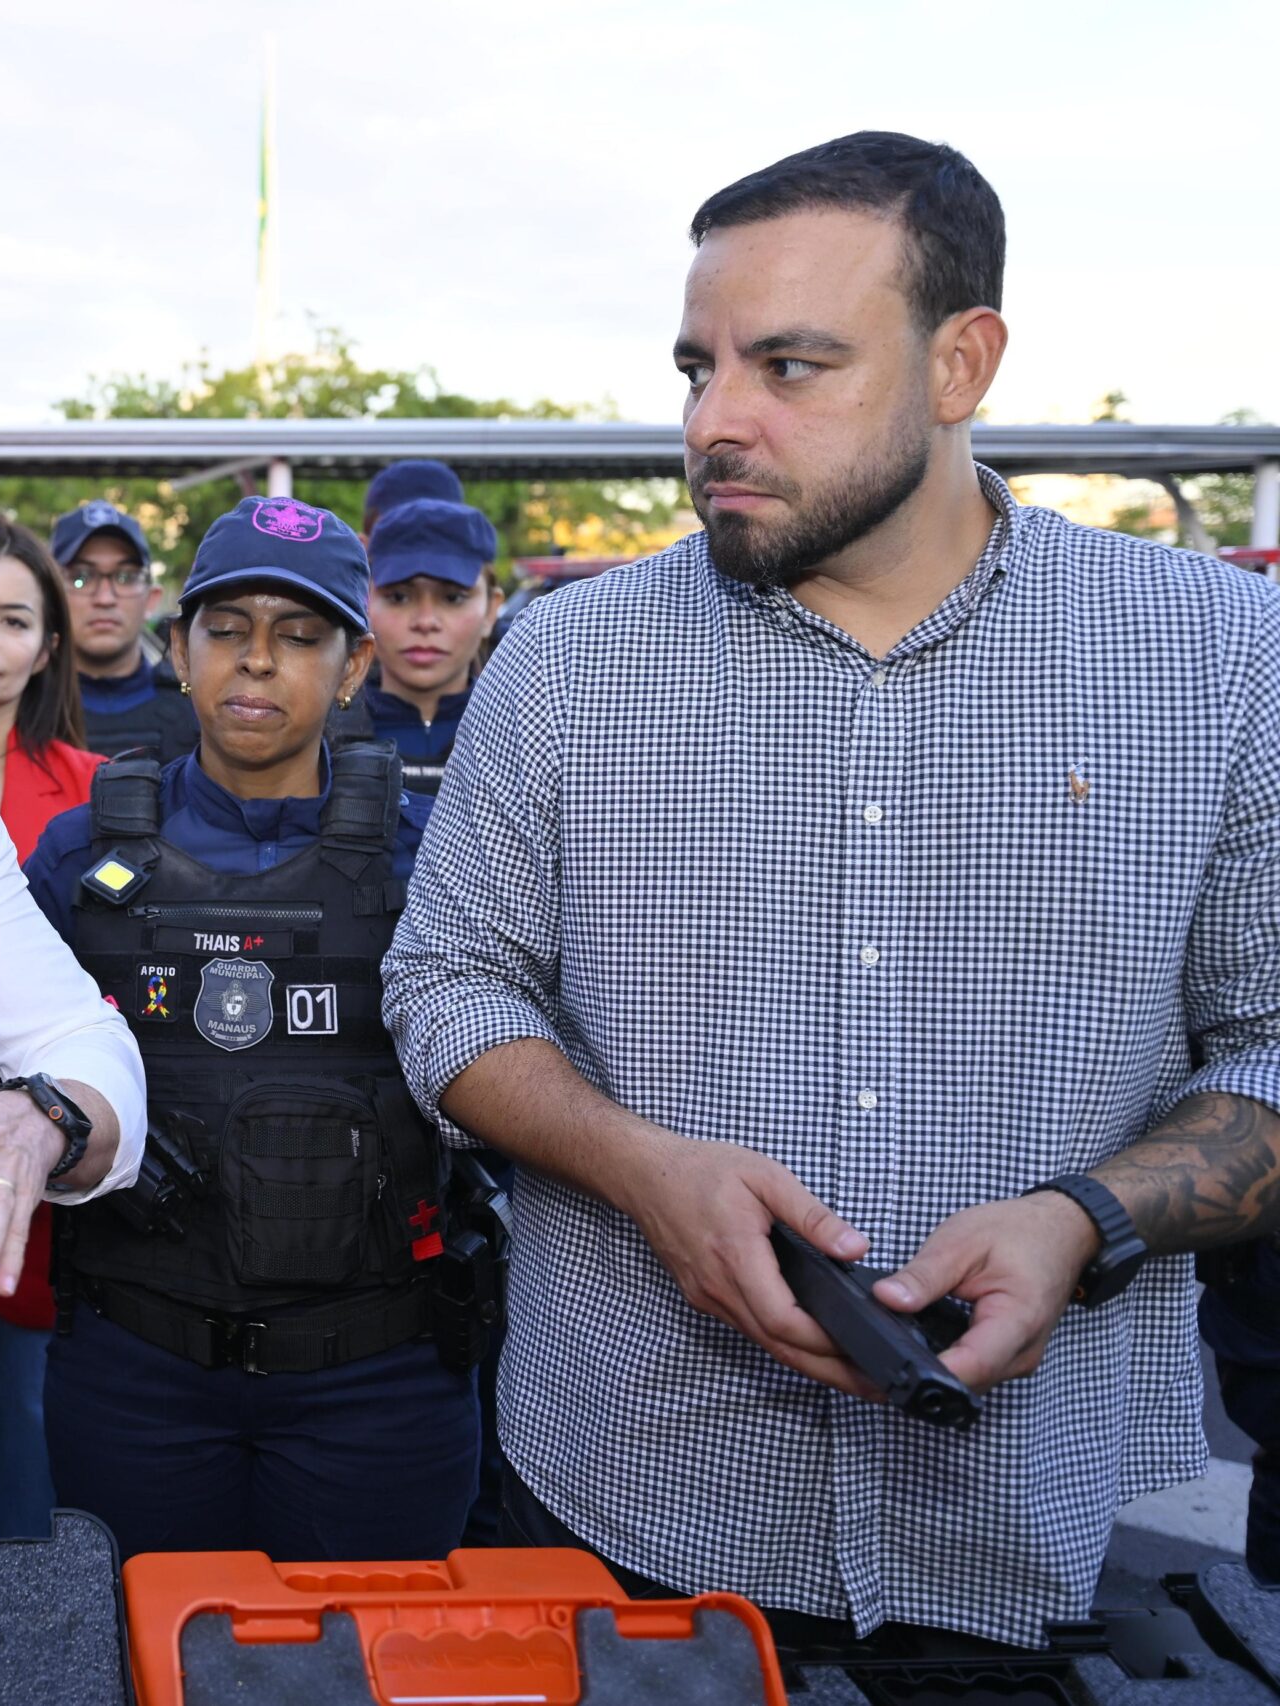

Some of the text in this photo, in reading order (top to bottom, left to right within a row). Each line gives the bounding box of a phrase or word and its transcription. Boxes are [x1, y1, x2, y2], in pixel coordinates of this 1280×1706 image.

[194, 933, 264, 952] THAIS A+
[140, 965, 176, 977] APOIO
[210, 966, 265, 979] MUNICIPAL
[216, 962, 258, 972] GUARDA
[291, 988, 332, 1029] 01
[207, 1020, 257, 1034] MANAUS
